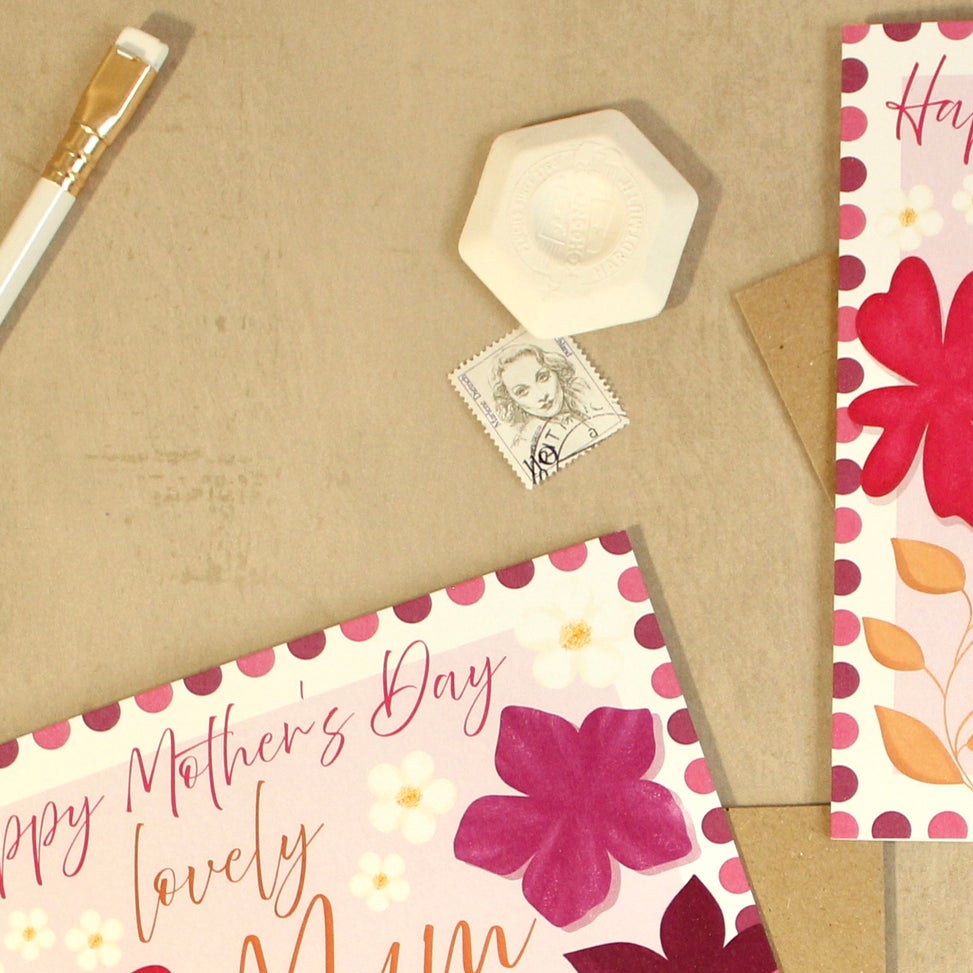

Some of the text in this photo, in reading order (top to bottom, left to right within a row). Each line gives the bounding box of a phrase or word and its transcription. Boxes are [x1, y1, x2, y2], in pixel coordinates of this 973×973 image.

[126, 680, 354, 818] Mother's
[370, 640, 507, 737] Day
[134, 780, 324, 943] lovely
